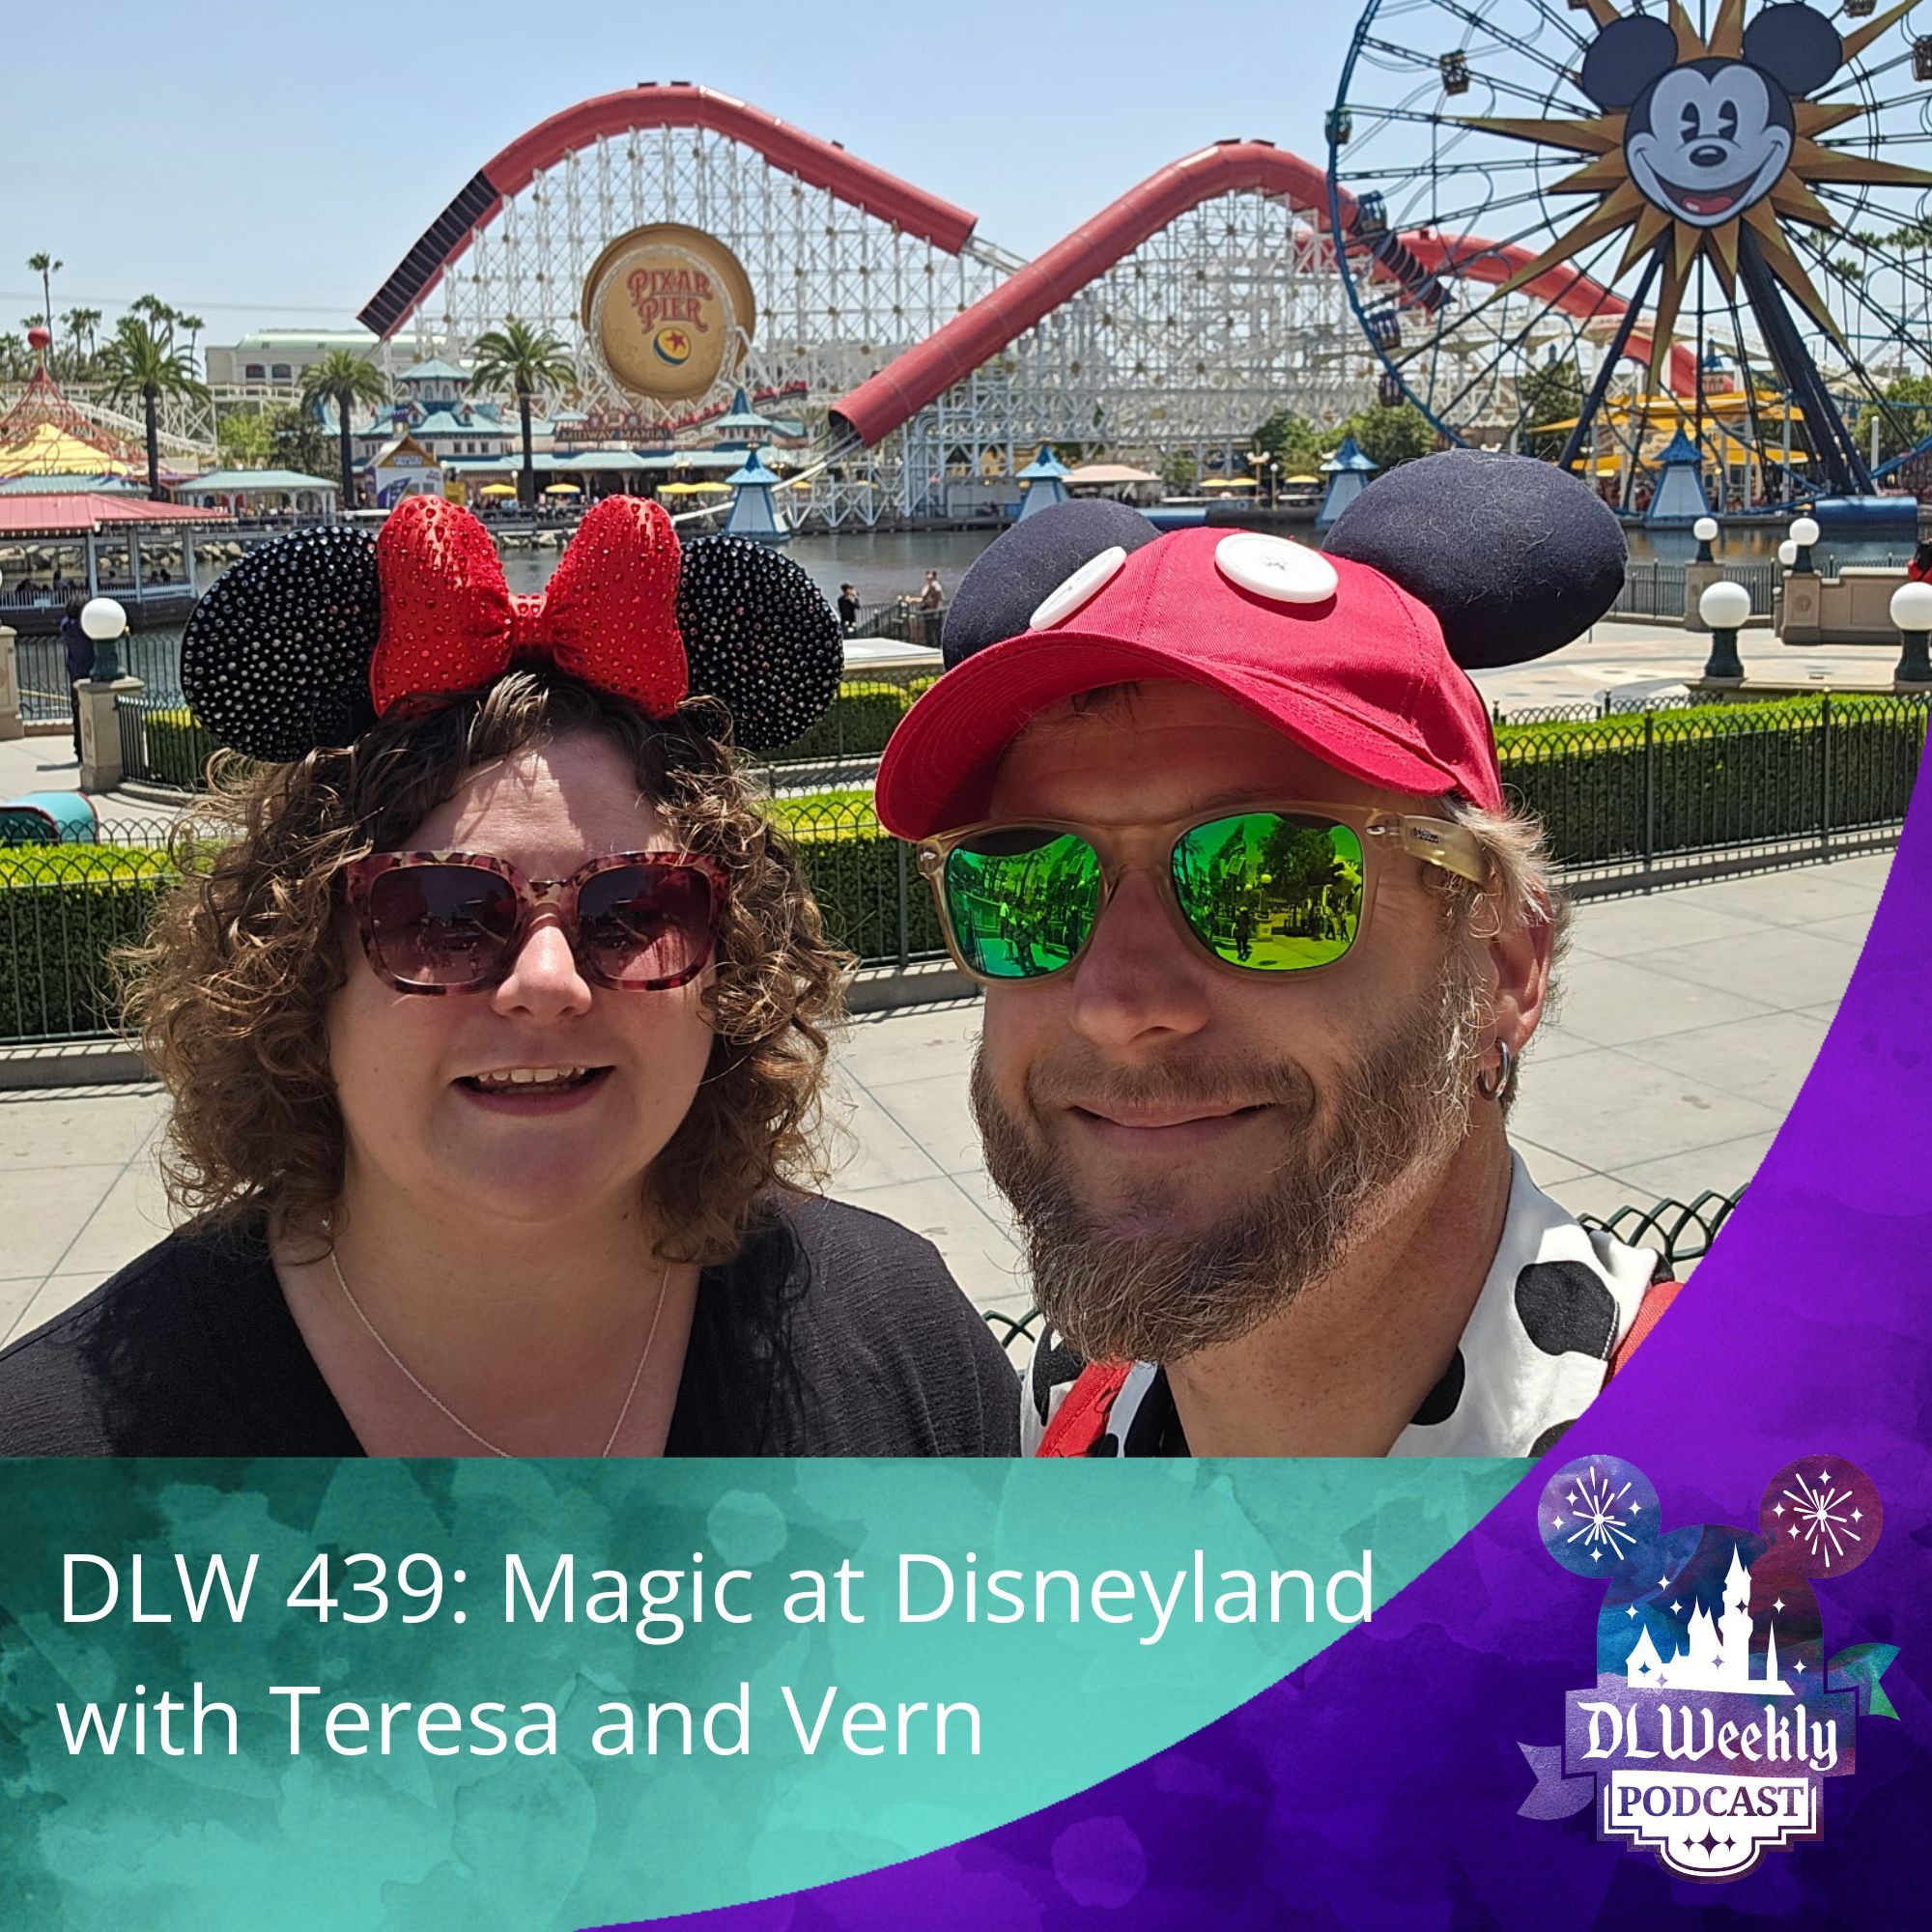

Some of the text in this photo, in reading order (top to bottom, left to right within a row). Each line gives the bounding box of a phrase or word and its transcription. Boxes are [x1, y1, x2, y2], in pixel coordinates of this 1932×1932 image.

[626, 269, 713, 306] PIXAR
[638, 296, 709, 334] PIER
[561, 430, 613, 440] MIDWAY
